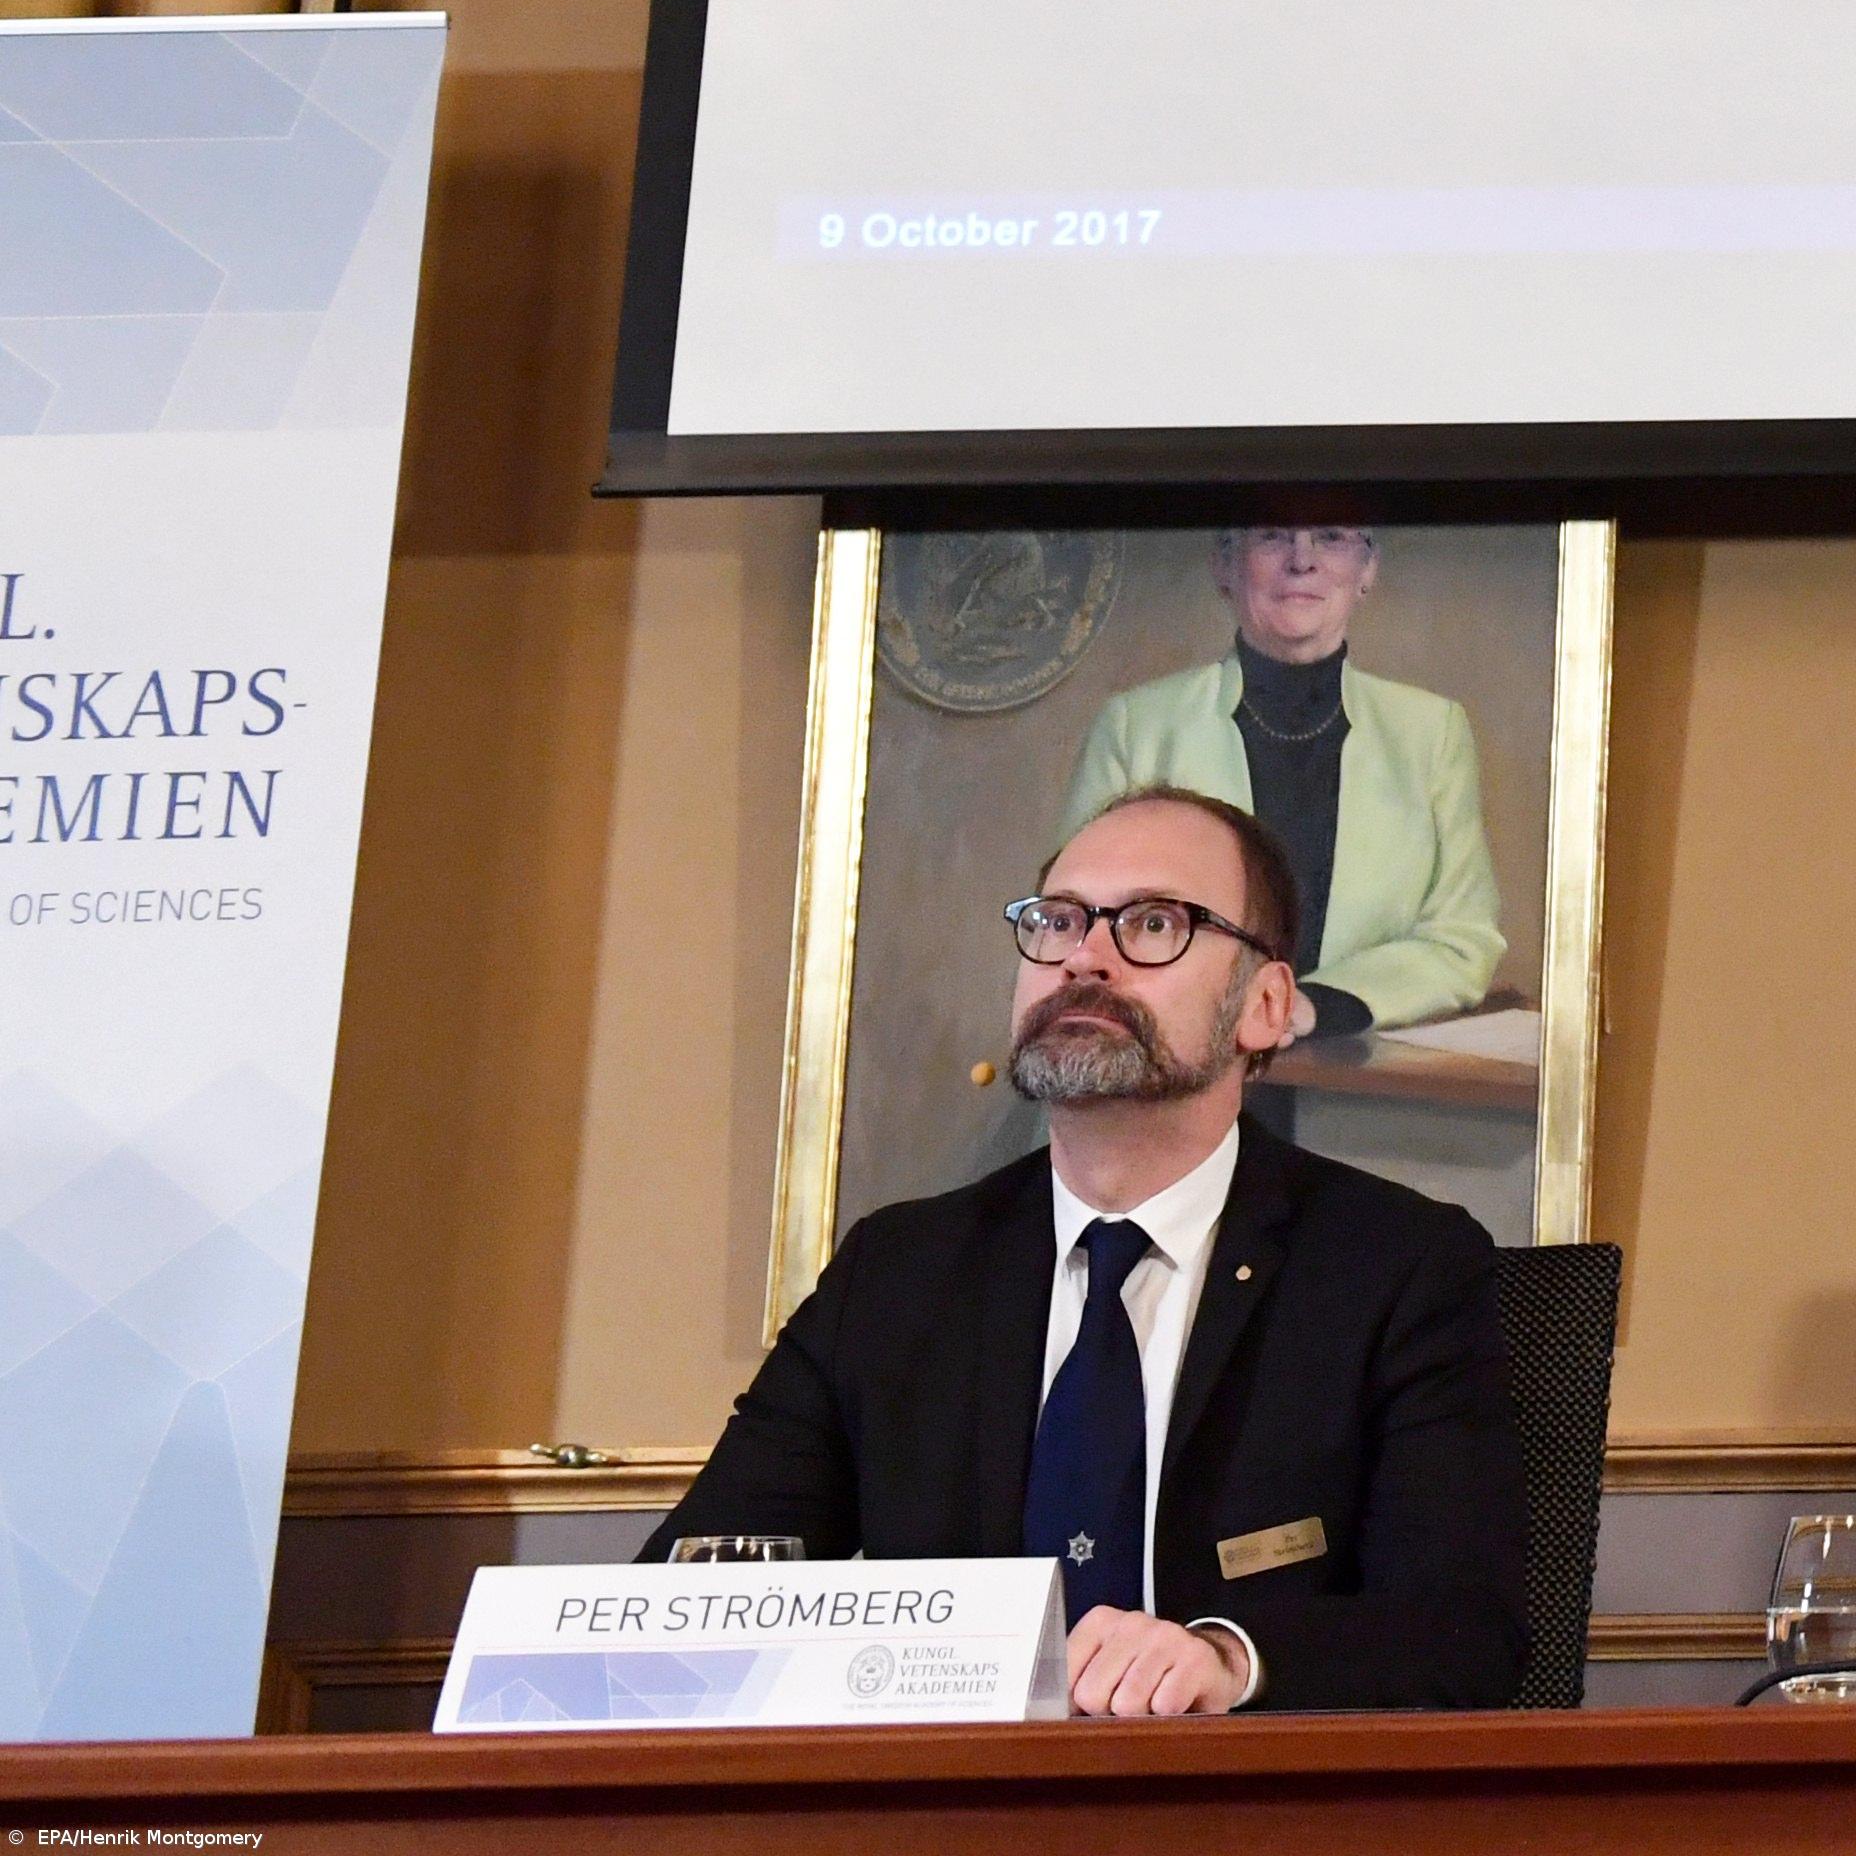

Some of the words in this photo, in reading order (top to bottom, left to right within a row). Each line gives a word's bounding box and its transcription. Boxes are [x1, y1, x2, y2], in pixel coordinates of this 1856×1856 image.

[818, 213, 845, 249] 9
[861, 212, 1039, 248] October
[1052, 209, 1162, 246] 2017
[0, 667, 307, 743] SKAPS-
[8, 892, 61, 927] OF
[69, 887, 263, 925] SCIENCES
[555, 1596, 650, 1633] PER
[663, 1585, 955, 1632] STRÖMBERG
